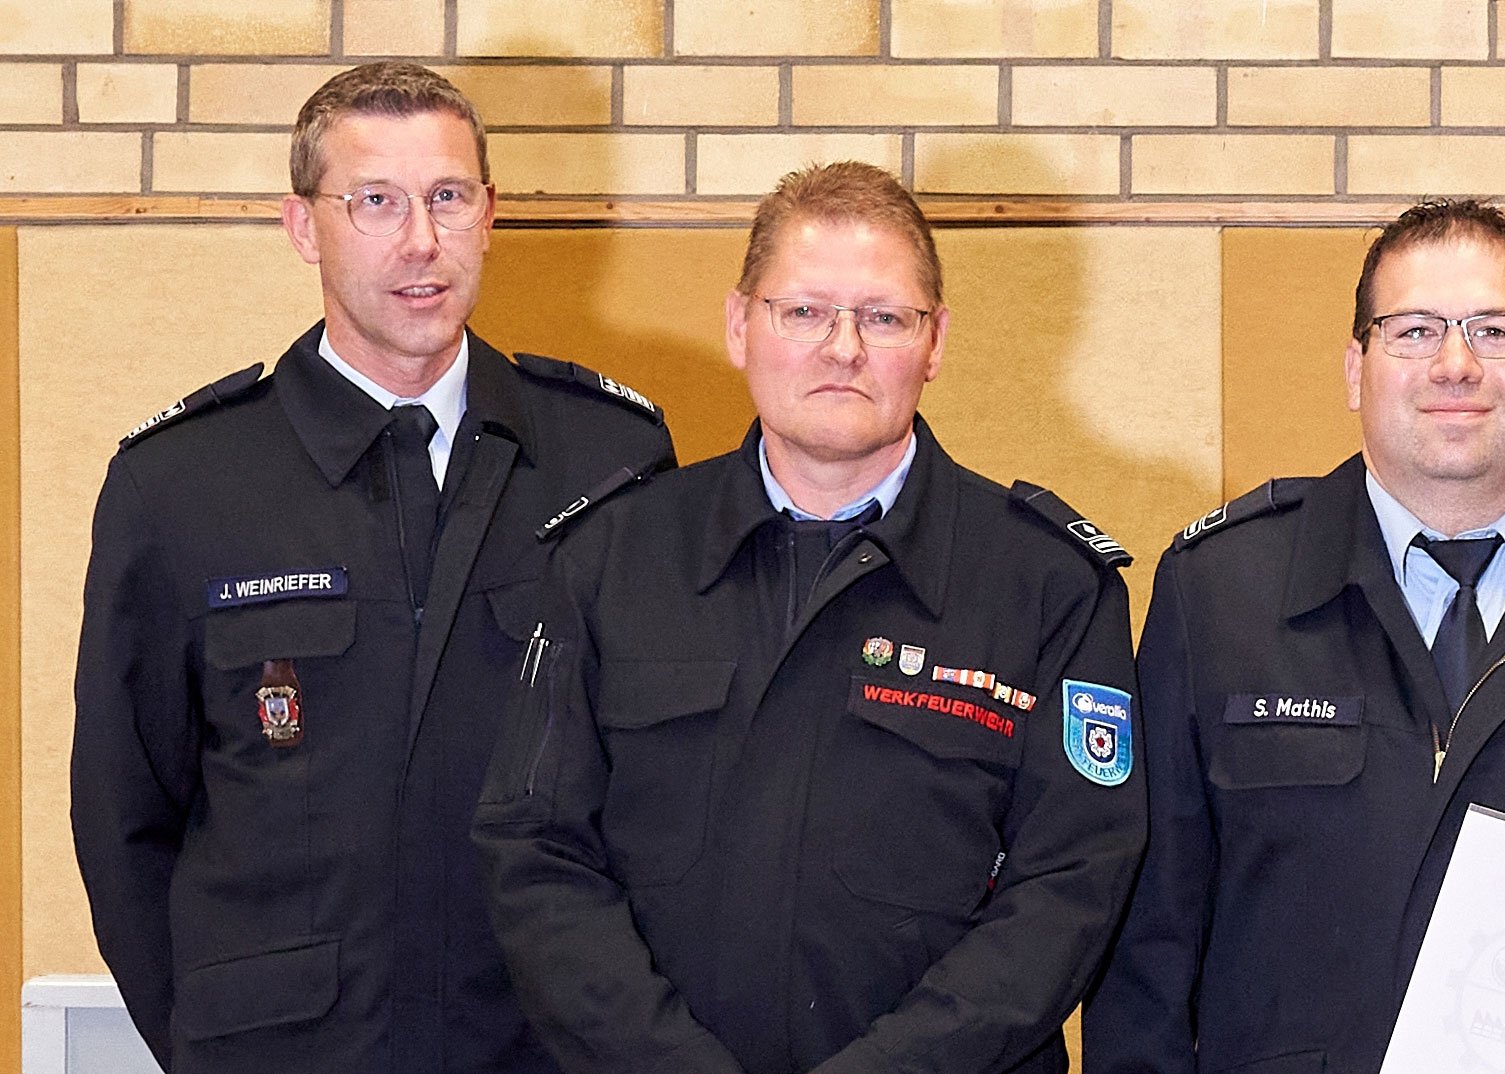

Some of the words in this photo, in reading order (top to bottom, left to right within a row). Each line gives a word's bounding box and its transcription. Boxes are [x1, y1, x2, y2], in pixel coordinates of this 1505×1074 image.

[220, 583, 232, 599] J.
[236, 573, 332, 598] WEINRIEFER
[863, 684, 1015, 739] WERKFEUERWEHR
[1253, 698, 1268, 717] S.
[1275, 697, 1336, 719] Mathis
